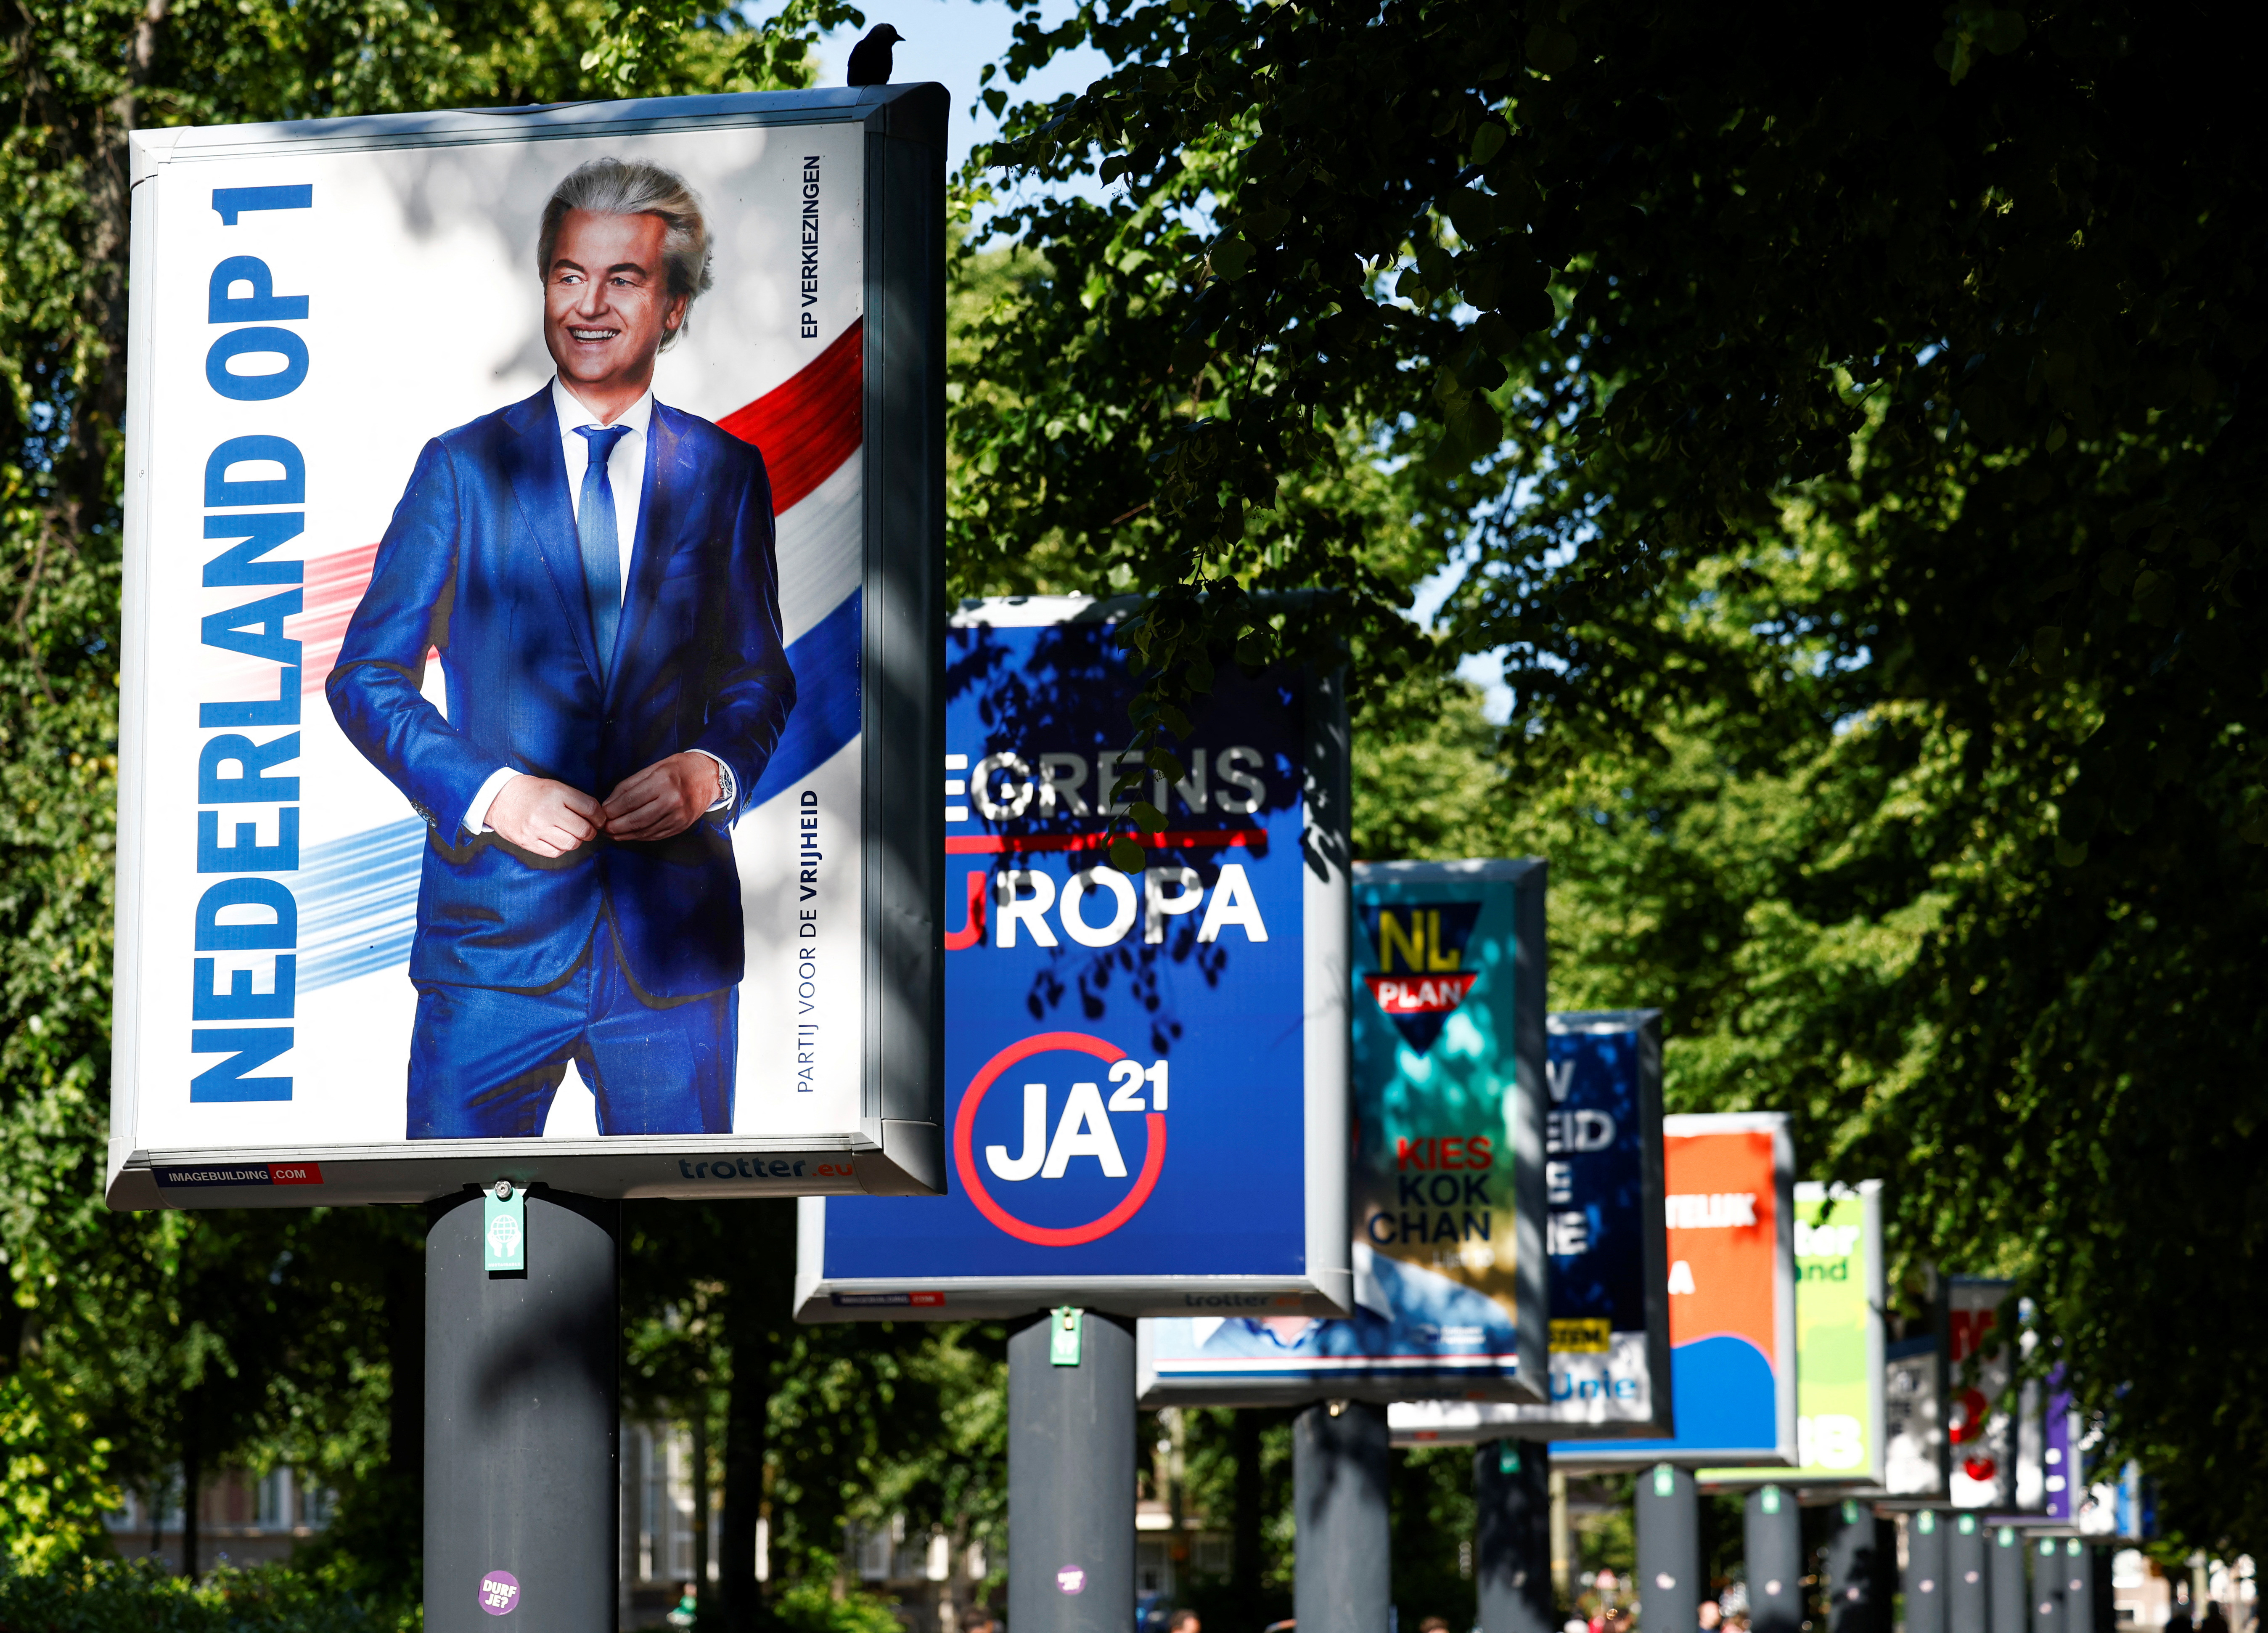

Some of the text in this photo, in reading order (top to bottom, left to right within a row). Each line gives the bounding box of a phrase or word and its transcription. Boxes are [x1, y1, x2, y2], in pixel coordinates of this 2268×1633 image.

[802, 156, 820, 338] EP VERKIEZINGEN
[191, 184, 312, 1102] NEDERLAND OP 1
[797, 790, 823, 1092] PARTIJ VOOR DE VRIJHEID
[1379, 909, 1460, 973] NL
[1378, 979, 1462, 1008] PLAN
[1397, 1135, 1493, 1171] KIES
[1398, 1174, 1492, 1207] KOK
[1369, 1211, 1491, 1244] CHAN
[482, 1579, 517, 1598] DURF
[485, 1593, 509, 1609] JE?
